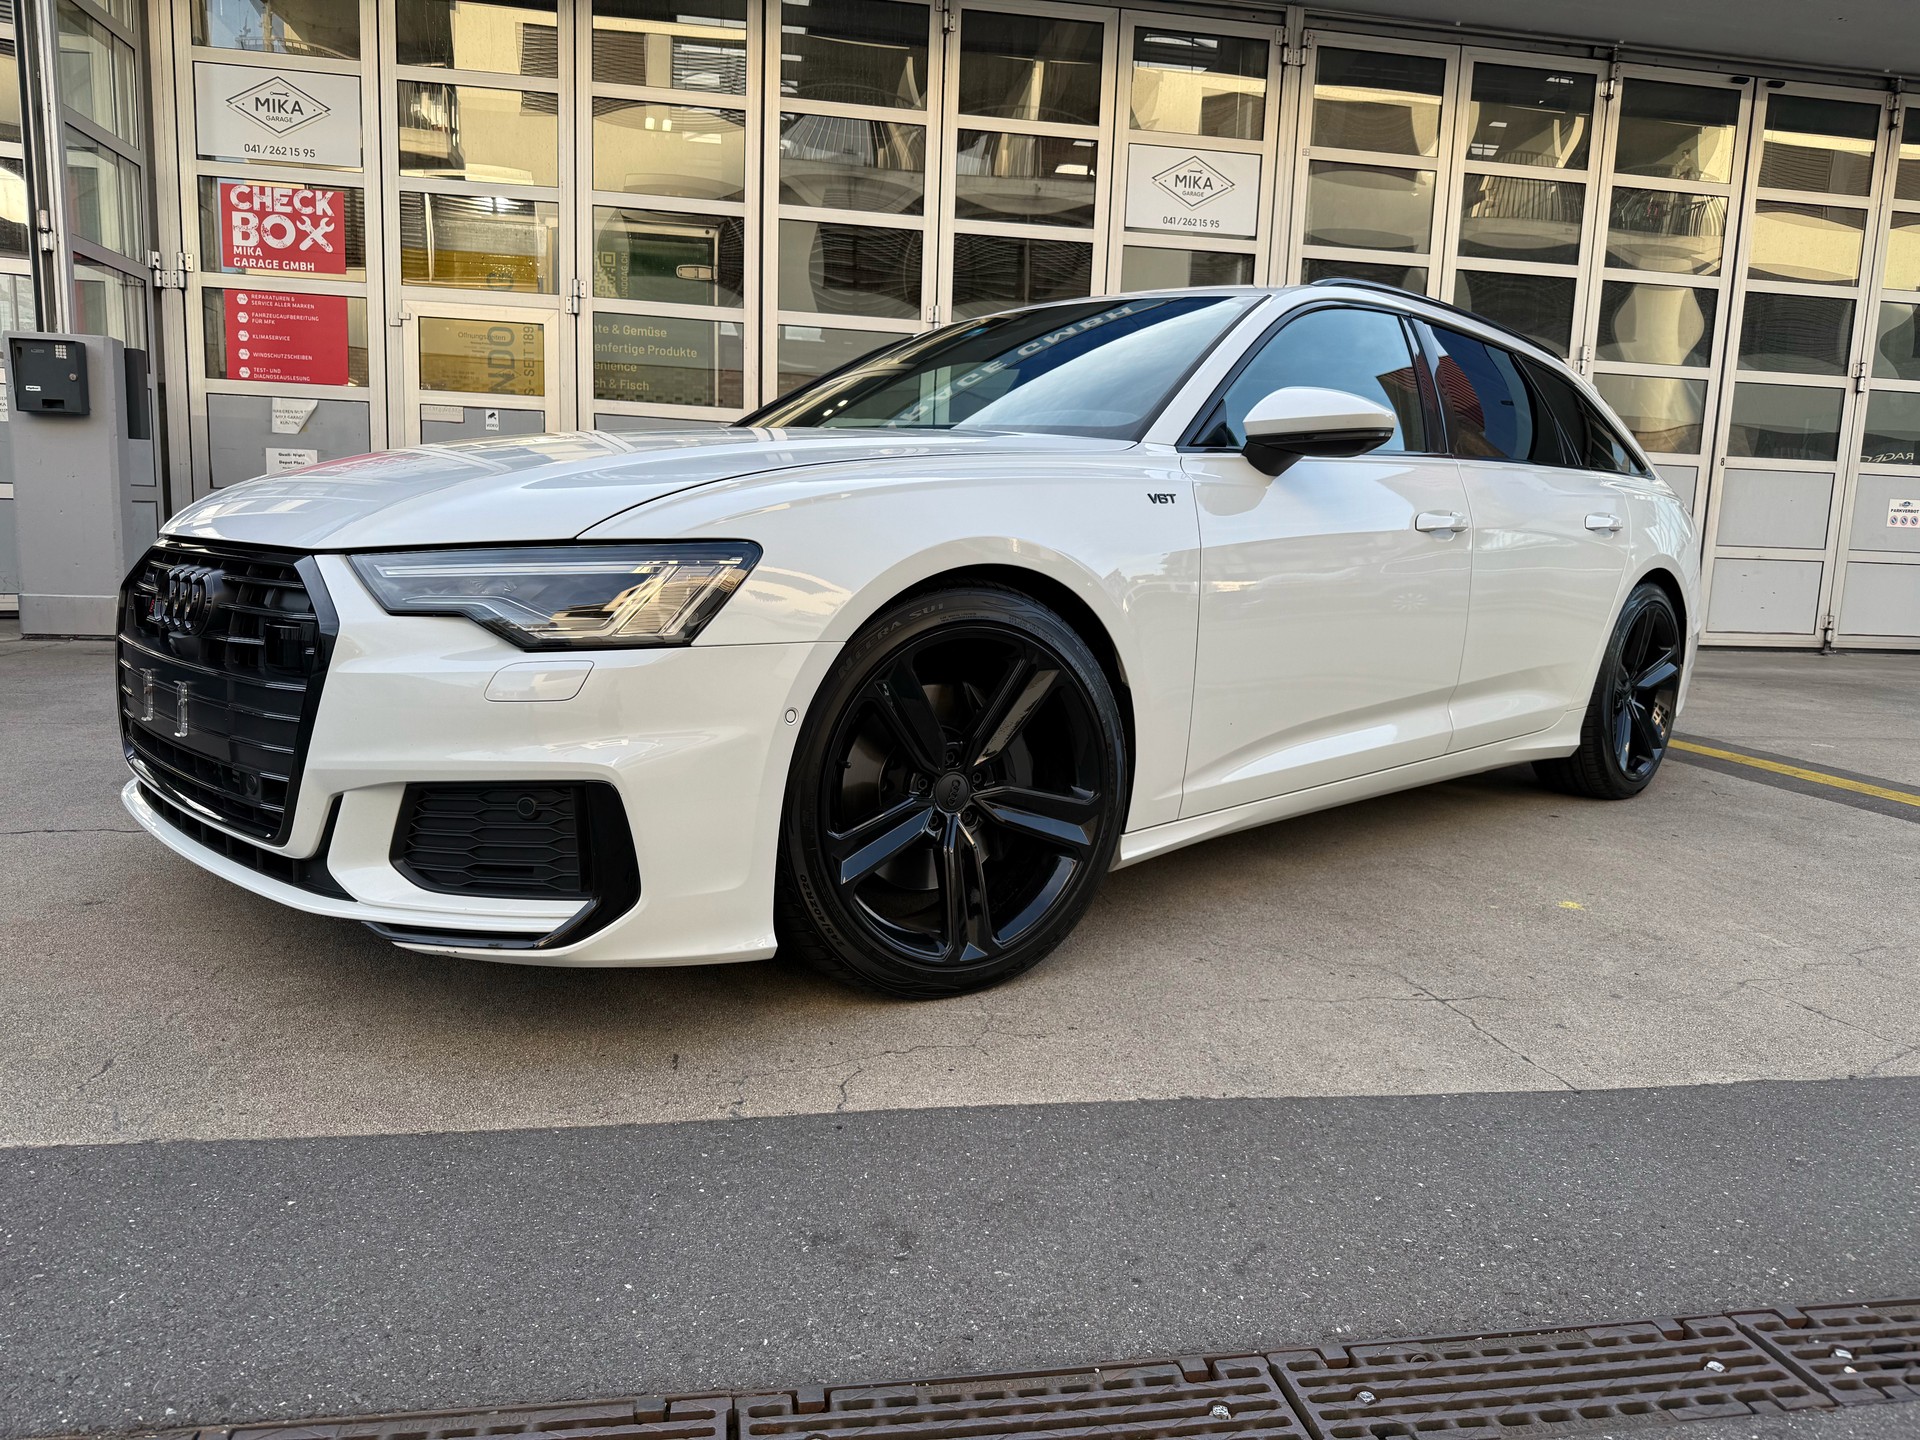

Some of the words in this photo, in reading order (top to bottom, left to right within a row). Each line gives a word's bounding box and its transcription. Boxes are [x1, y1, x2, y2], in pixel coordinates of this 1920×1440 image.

[255, 96, 304, 116] MIKA
[265, 115, 293, 123] GARAGE
[289, 146, 300, 157] 15
[303, 148, 316, 158] 95
[1174, 174, 1214, 191] MIKA
[1181, 190, 1205, 198] GARAGE
[229, 184, 335, 217] CHECK
[1199, 217, 1208, 227] 15
[1210, 219, 1220, 228] 95
[232, 211, 335, 253] BOX
[233, 245, 263, 257] MIKA
[233, 257, 279, 269] GARAGE
[282, 260, 315, 272] GMBH
[251, 294, 290, 302] REPARATUREN
[251, 312, 319, 322] FAHRZEUGAUFBEREITUNG
[611, 324, 620, 334] &
[622, 324, 667, 338] Gemüse
[253, 352, 313, 360] WINDSCHUTZSCHEIBEN
[647, 344, 698, 358] Produkte
[523, 348, 535, 377] SEIT
[253, 373, 310, 381] DIAGNOSEAUSLESUNG
[608, 379, 617, 388] &
[619, 379, 650, 391] Fisch
[1720, 457, 1725, 466] 8
[1147, 493, 1176, 504] V6T
